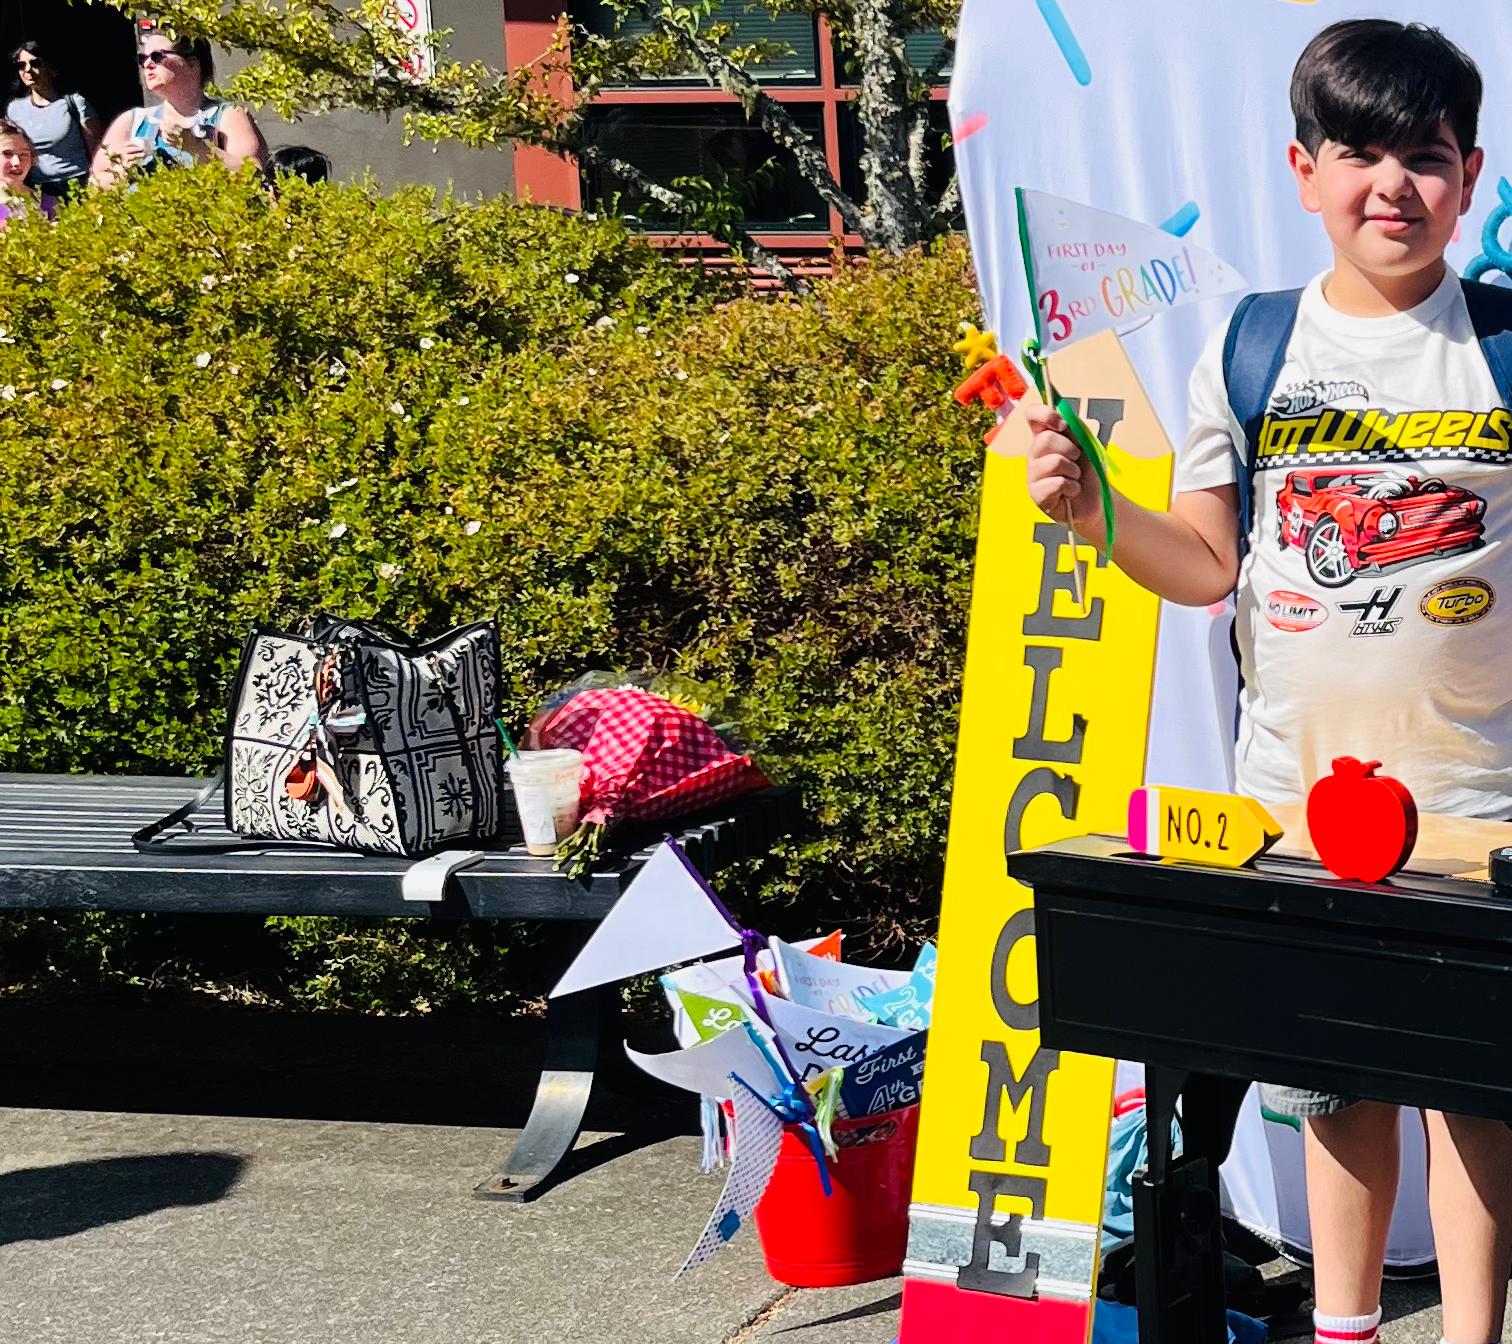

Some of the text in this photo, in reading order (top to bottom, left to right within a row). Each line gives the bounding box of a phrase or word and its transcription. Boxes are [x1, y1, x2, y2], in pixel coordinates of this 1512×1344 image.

[1047, 242, 1127, 258] FIRST DAY
[1038, 247, 1201, 342] 3RD GRADE!
[1257, 414, 1318, 457] OT
[1437, 593, 1484, 610] Turbo
[958, 397, 1125, 1299] ELCOME
[795, 1026, 887, 1068] Las
[855, 1047, 917, 1085] First
